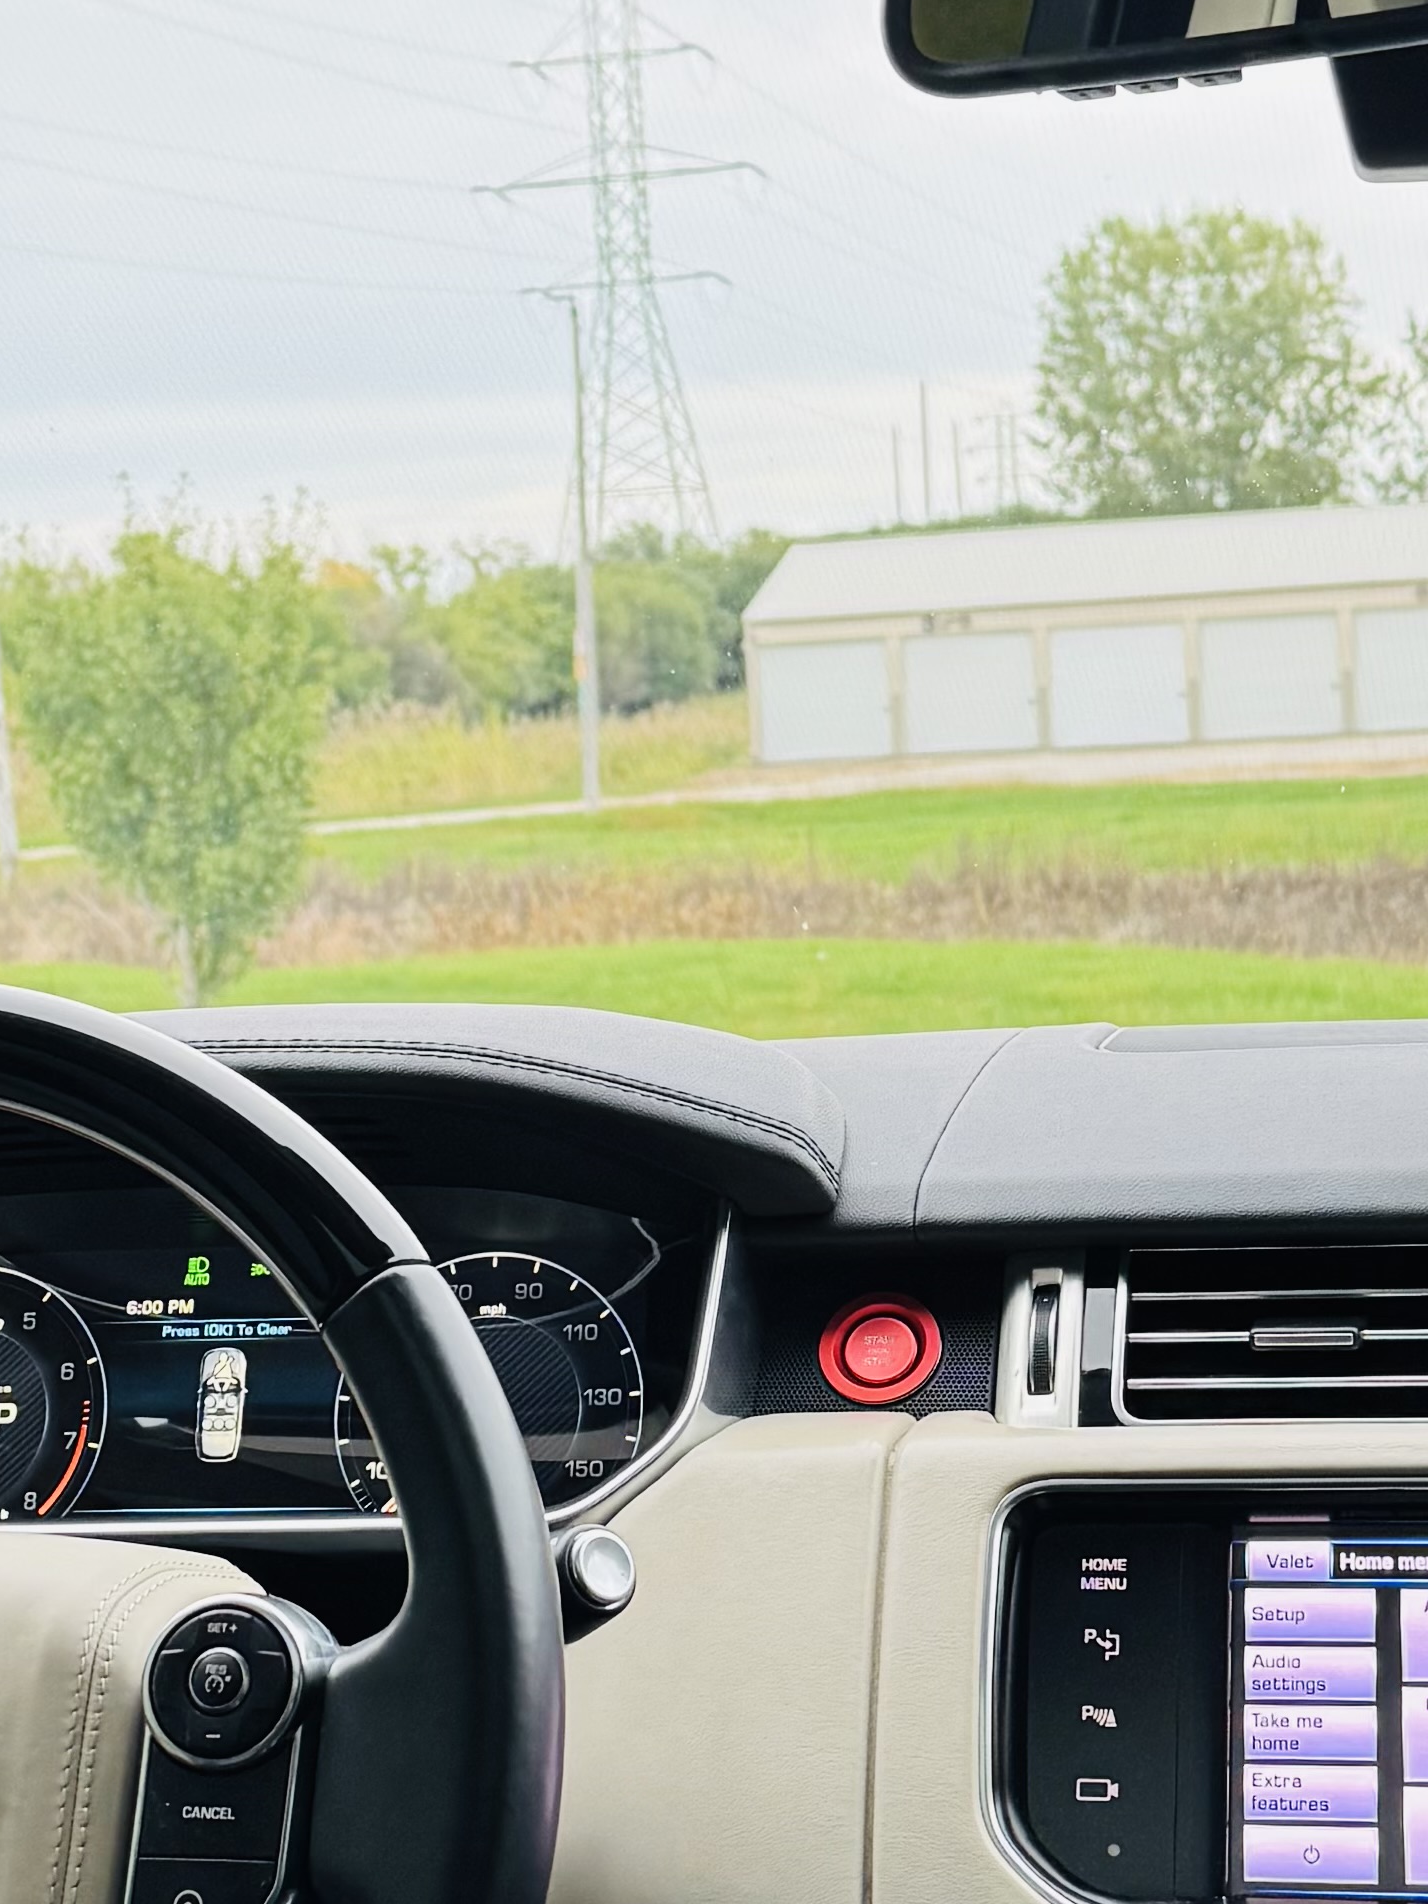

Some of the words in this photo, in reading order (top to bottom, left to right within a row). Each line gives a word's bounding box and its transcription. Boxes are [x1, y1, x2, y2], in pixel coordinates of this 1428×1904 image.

[184, 1273, 210, 1286] AUTO
[514, 1283, 543, 1300] 90
[126, 1299, 163, 1315] 6:00
[168, 1298, 195, 1314] PM
[479, 1303, 507, 1316] mph
[22, 1312, 37, 1330] 5
[161, 1324, 200, 1338] Press
[236, 1324, 254, 1336] To
[257, 1322, 292, 1336] Clear
[562, 1323, 599, 1341] 110
[60, 1362, 75, 1381] 6
[582, 1387, 623, 1406] 130
[63, 1431, 78, 1450] 7
[564, 1459, 603, 1478] 150
[23, 1491, 37, 1511] 8
[1081, 1558, 1128, 1572] HOME
[1266, 1553, 1315, 1569] Valet
[1339, 1551, 1394, 1572] Home
[1080, 1576, 1128, 1591] MENU
[1252, 1606, 1305, 1625] Setup
[204, 1664, 228, 1674] RES
[1252, 1653, 1301, 1670] Audio
[1251, 1674, 1326, 1695] settings
[1252, 1713, 1292, 1730] Take
[1301, 1716, 1323, 1730] me
[1251, 1735, 1299, 1752] home
[1252, 1772, 1302, 1789] Extra
[1251, 1794, 1330, 1813] features
[182, 1805, 236, 1821] CANCEL
